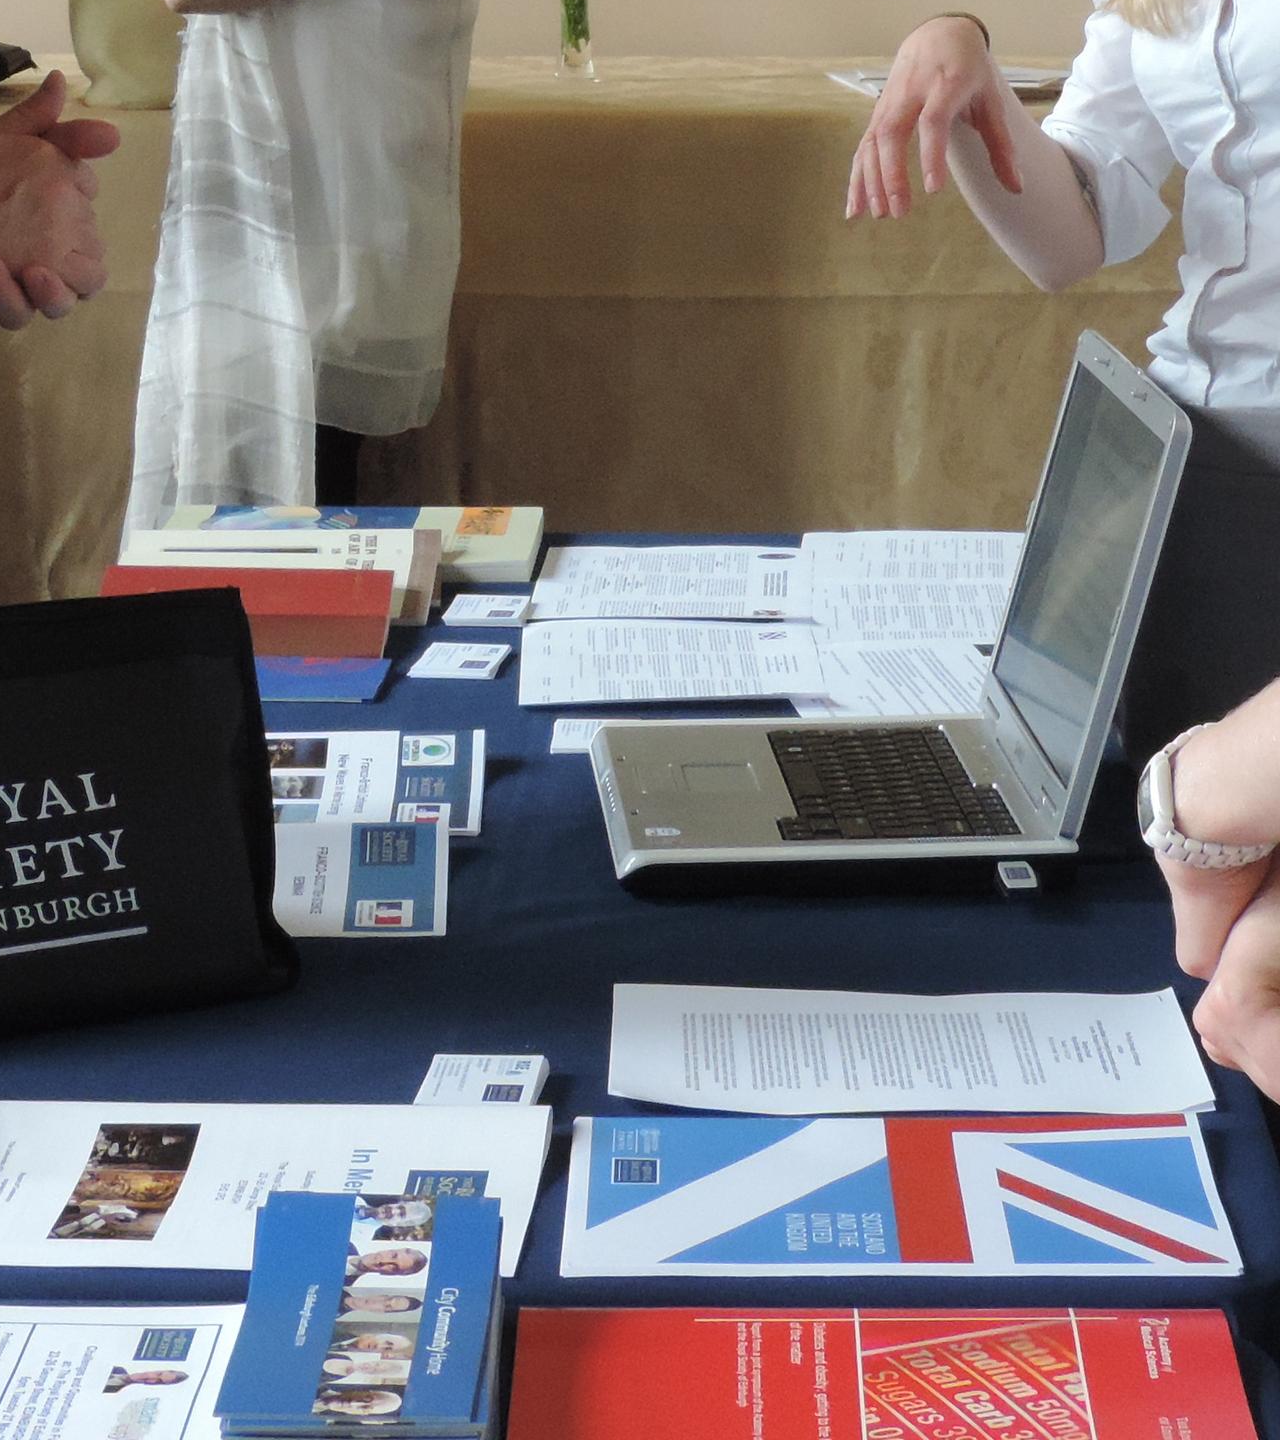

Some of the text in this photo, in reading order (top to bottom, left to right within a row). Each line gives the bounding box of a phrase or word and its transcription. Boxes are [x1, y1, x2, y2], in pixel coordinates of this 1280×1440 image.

[337, 753, 351, 767] New
[381, 831, 397, 863] SOCIETY
[350, 1149, 379, 1163] In
[785, 1213, 808, 1251] KINGDOM
[811, 1213, 833, 1244] UNITED
[837, 1213, 859, 1248] AND THE
[862, 1213, 886, 1255] SCOTLAND
[426, 1287, 460, 1376] City Community Home
[789, 1328, 801, 1340] the
[812, 1322, 827, 1350] Diabetes
[735, 1355, 747, 1375] Society
[789, 1340, 802, 1365] matter
[813, 1350, 827, 1364] and
[1002, 1333, 1072, 1372] Total
[1139, 1325, 1160, 1379] Medical Sciences
[1156, 1336, 1174, 1366] Academy
[950, 1340, 1038, 1398] Sodium
[812, 1392, 829, 1417] getting
[864, 1370, 944, 1424] Sugars
[901, 1349, 1016, 1429] Total Carb
[816, 1416, 829, 1425] to
